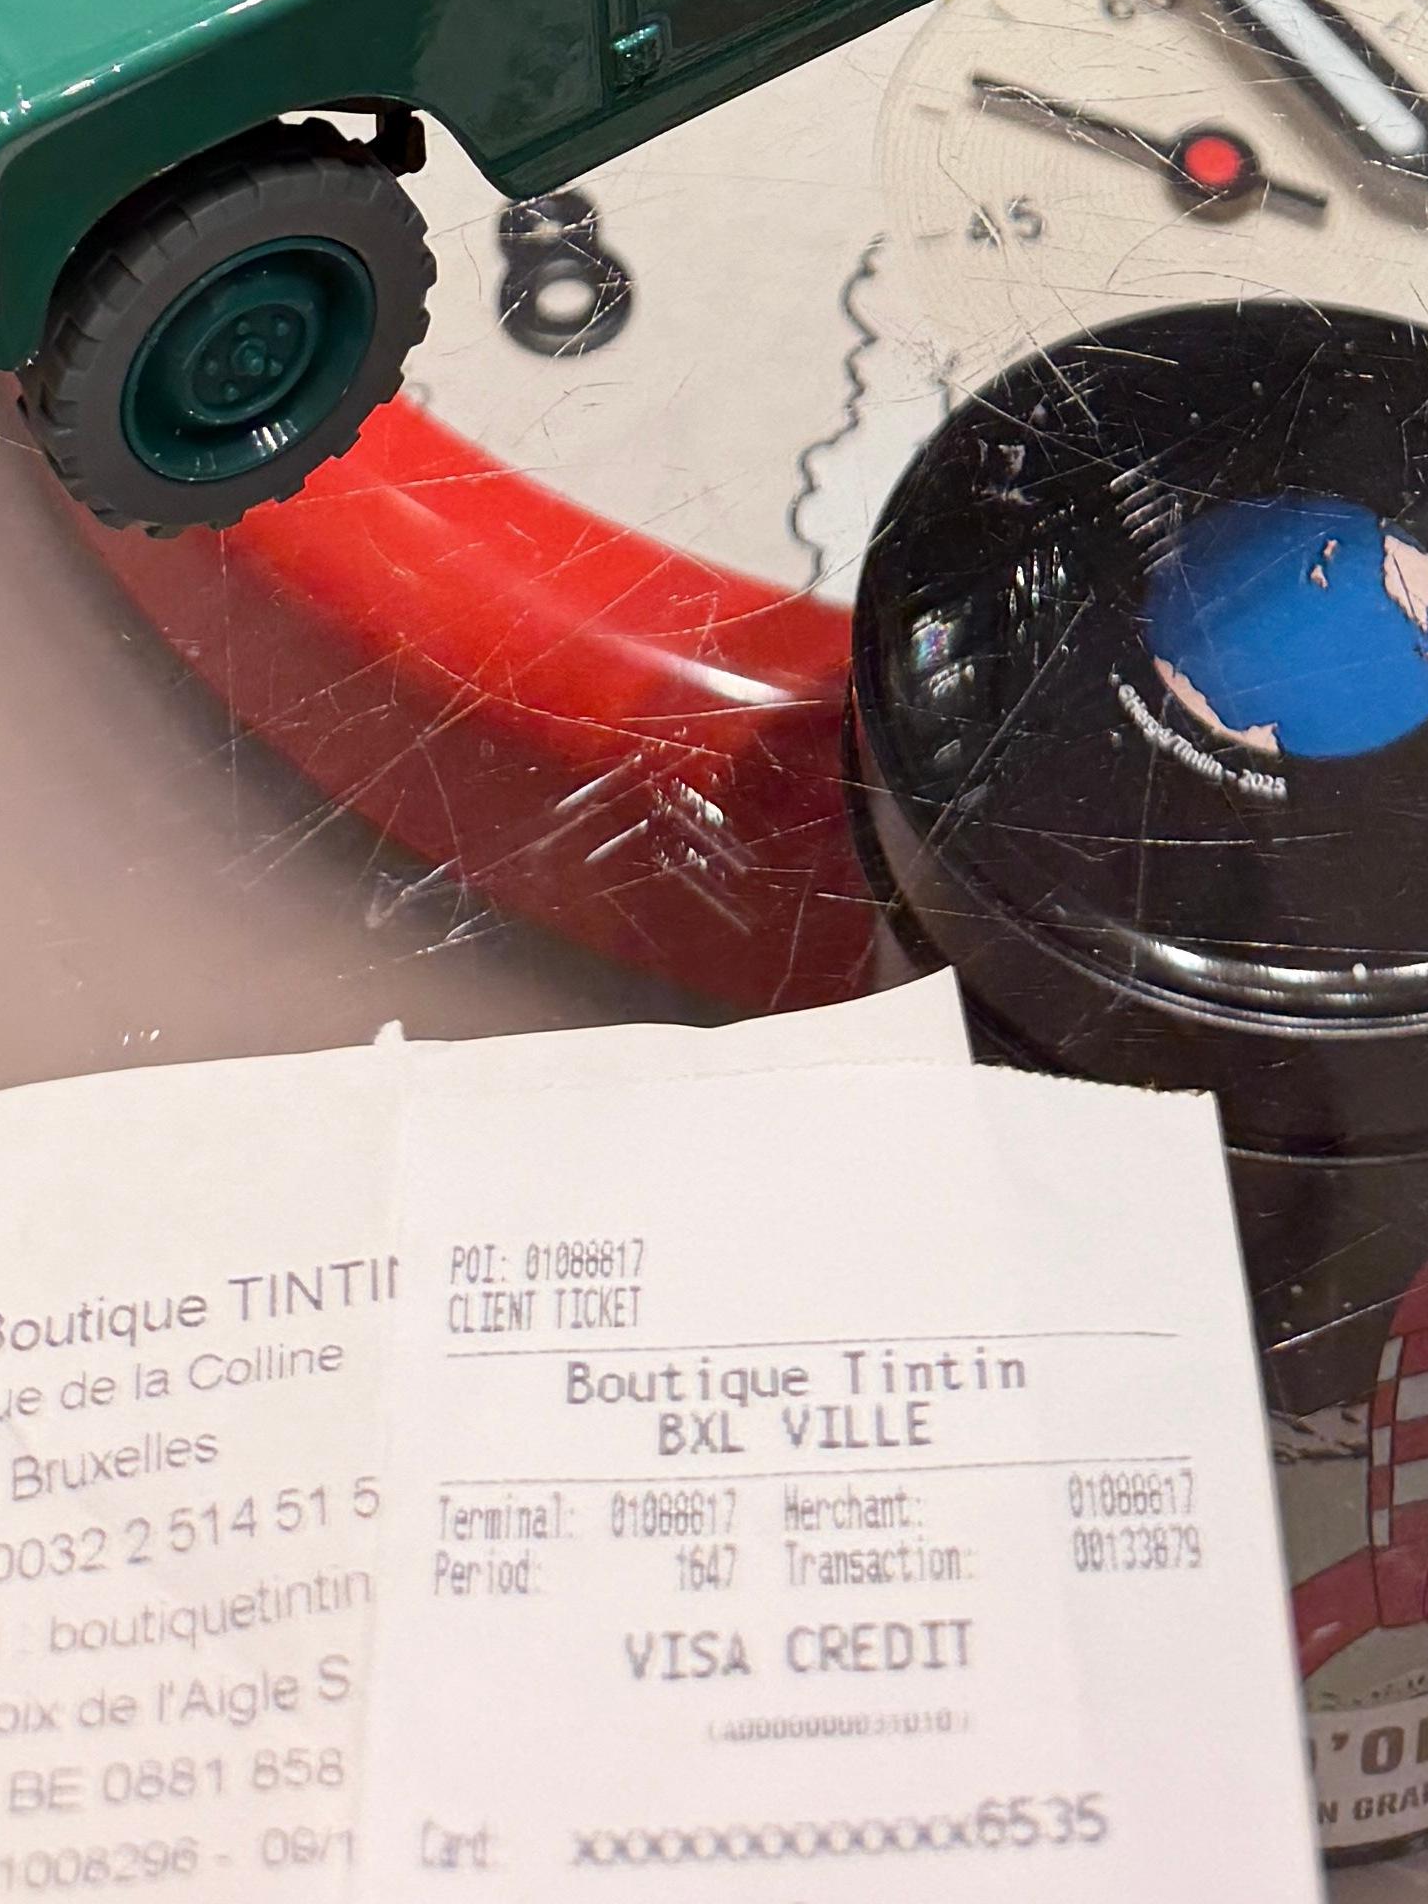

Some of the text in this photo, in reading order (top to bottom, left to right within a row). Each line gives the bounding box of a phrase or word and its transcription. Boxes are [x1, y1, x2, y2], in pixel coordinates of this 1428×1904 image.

[498, 188, 635, 358] 8
[450, 1237, 645, 1284] POI: 01088817
[448, 1285, 642, 1334] CLIENT TICKET
[59, 1371, 116, 1410] de
[134, 1363, 171, 1401] la
[188, 1343, 345, 1392] Colline
[565, 1346, 1026, 1408] Boutique Tintin
[657, 1400, 933, 1456] BXL VILLE
[12, 1431, 219, 1501] Bruxelles
[124, 1517, 153, 1565] 2
[170, 1496, 258, 1554] 514
[274, 1485, 328, 1533] 51
[351, 1476, 381, 1520] 5
[438, 1466, 1194, 1541] Terminal: 01088817 Merchant: 01088817
[675, 1543, 737, 1592] 1647
[49, 1564, 373, 1651] boutiquetintin
[623, 1617, 974, 1681] VISA CREDIT
[77, 1688, 139, 1730] de
[157, 1670, 301, 1730] l'Aigle
[317, 1651, 351, 1703] S
[8, 1767, 86, 1816] BE
[102, 1755, 226, 1807] 0881
[251, 1747, 345, 1792] 858
